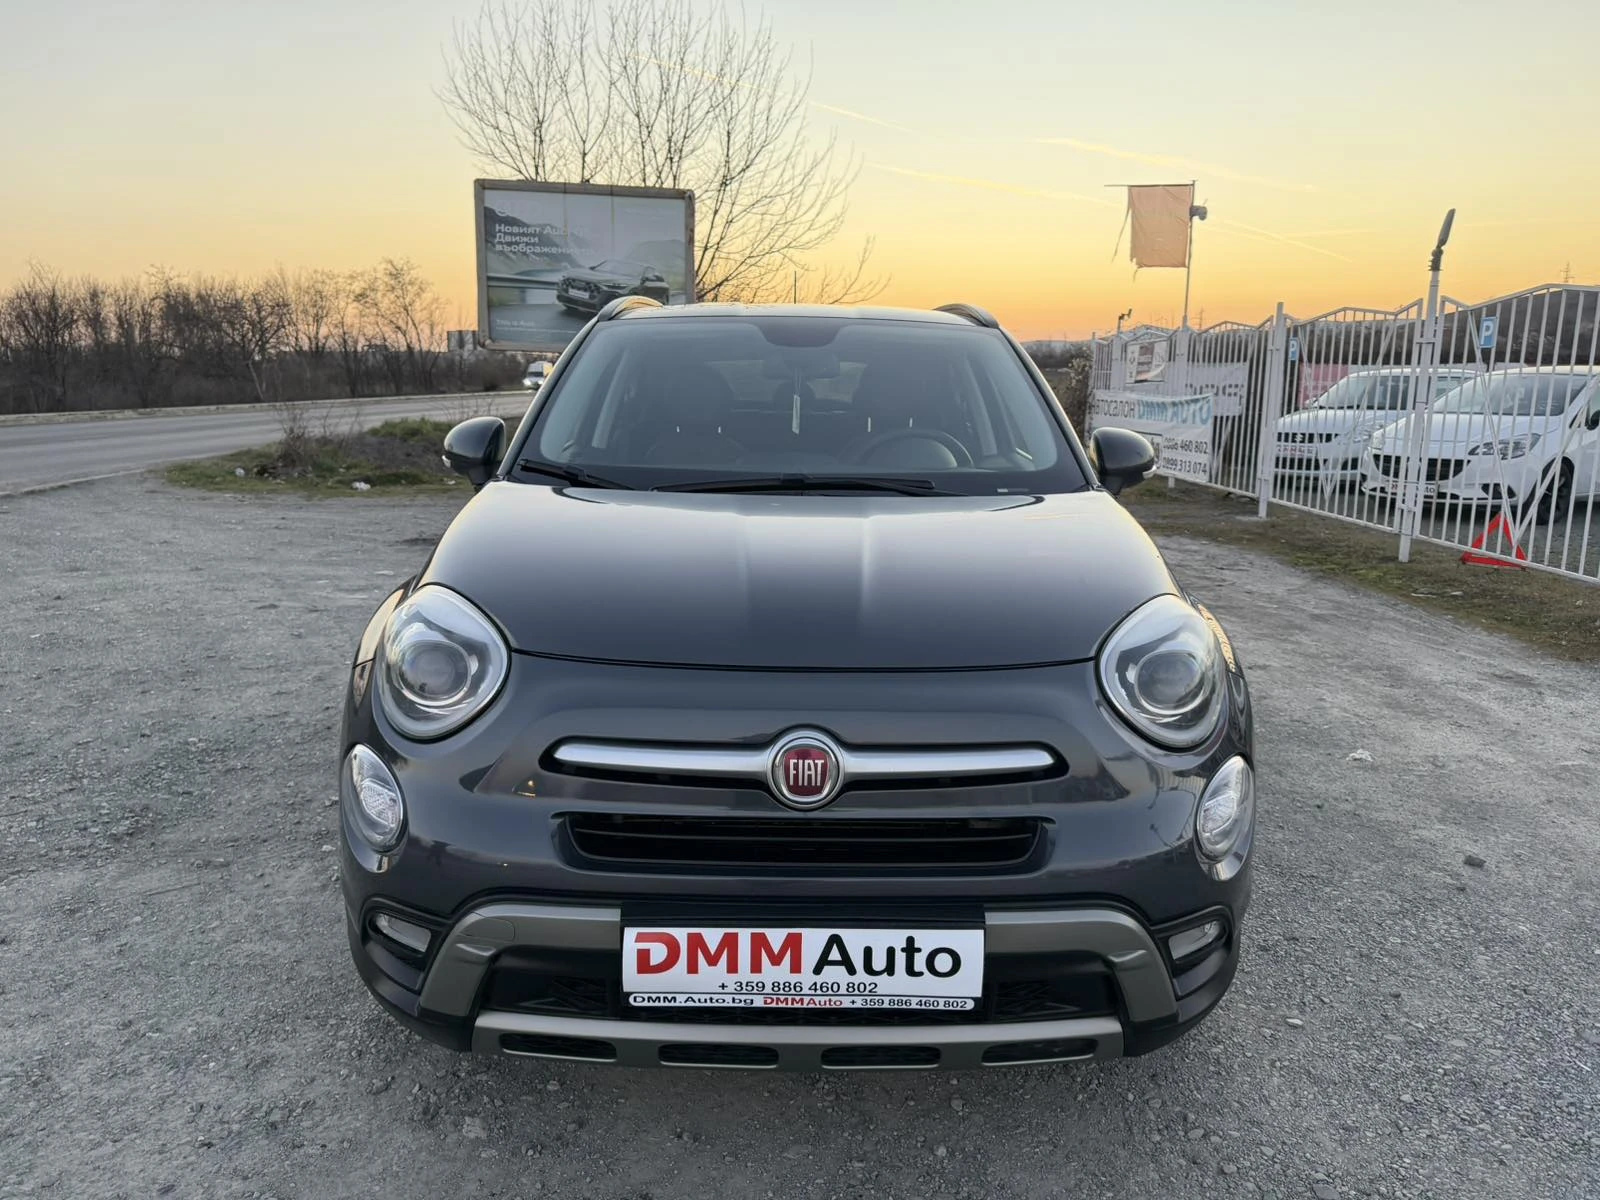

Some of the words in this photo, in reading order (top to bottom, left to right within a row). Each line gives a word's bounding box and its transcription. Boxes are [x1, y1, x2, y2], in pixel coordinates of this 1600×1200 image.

[495, 223, 540, 234] Новият
[543, 225, 571, 235] Au
[495, 232, 539, 243] Движи
[495, 243, 595, 254] въображени
[1481, 322, 1493, 345] P
[1180, 439, 1193, 452] 460
[1194, 440, 1208, 454] 802
[1179, 459, 1192, 473] 313
[1193, 461, 1207, 475] 074
[789, 759, 825, 786] FIAT
[734, 981, 765, 992] 359
[771, 981, 803, 993] 886
[808, 981, 840, 993] 460
[846, 982, 878, 994] 802
[633, 995, 754, 1005] DMM.Auto.bg
[861, 998, 885, 1007] 359
[888, 998, 912, 1008] 886
[916, 1000, 940, 1009] 460
[943, 1000, 967, 1009] 802
